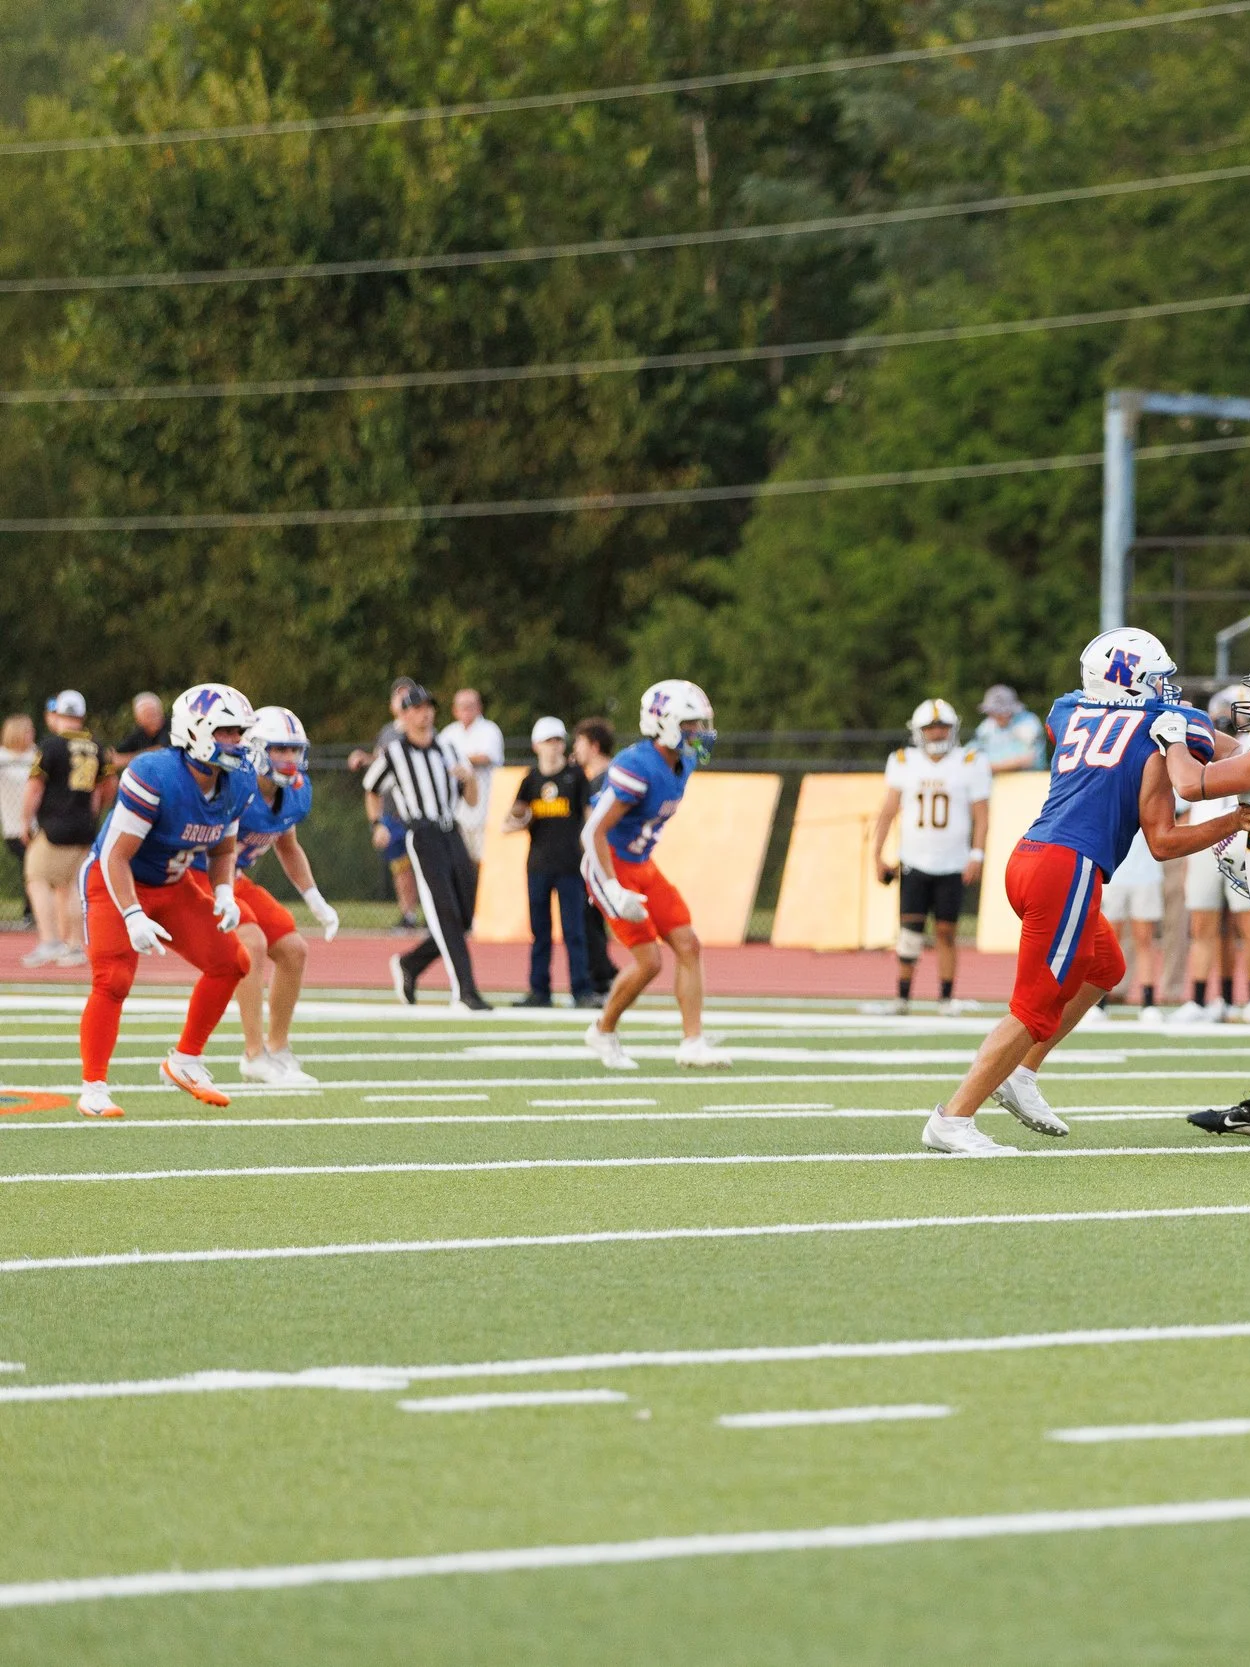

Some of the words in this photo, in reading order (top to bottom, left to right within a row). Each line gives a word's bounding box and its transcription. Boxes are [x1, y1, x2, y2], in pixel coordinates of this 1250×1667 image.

[1103, 649, 1141, 688] N
[189, 689, 221, 716] N
[1056, 705, 1147, 774] 50
[916, 792, 950, 829] 10
[181, 823, 225, 843] BRUINS
